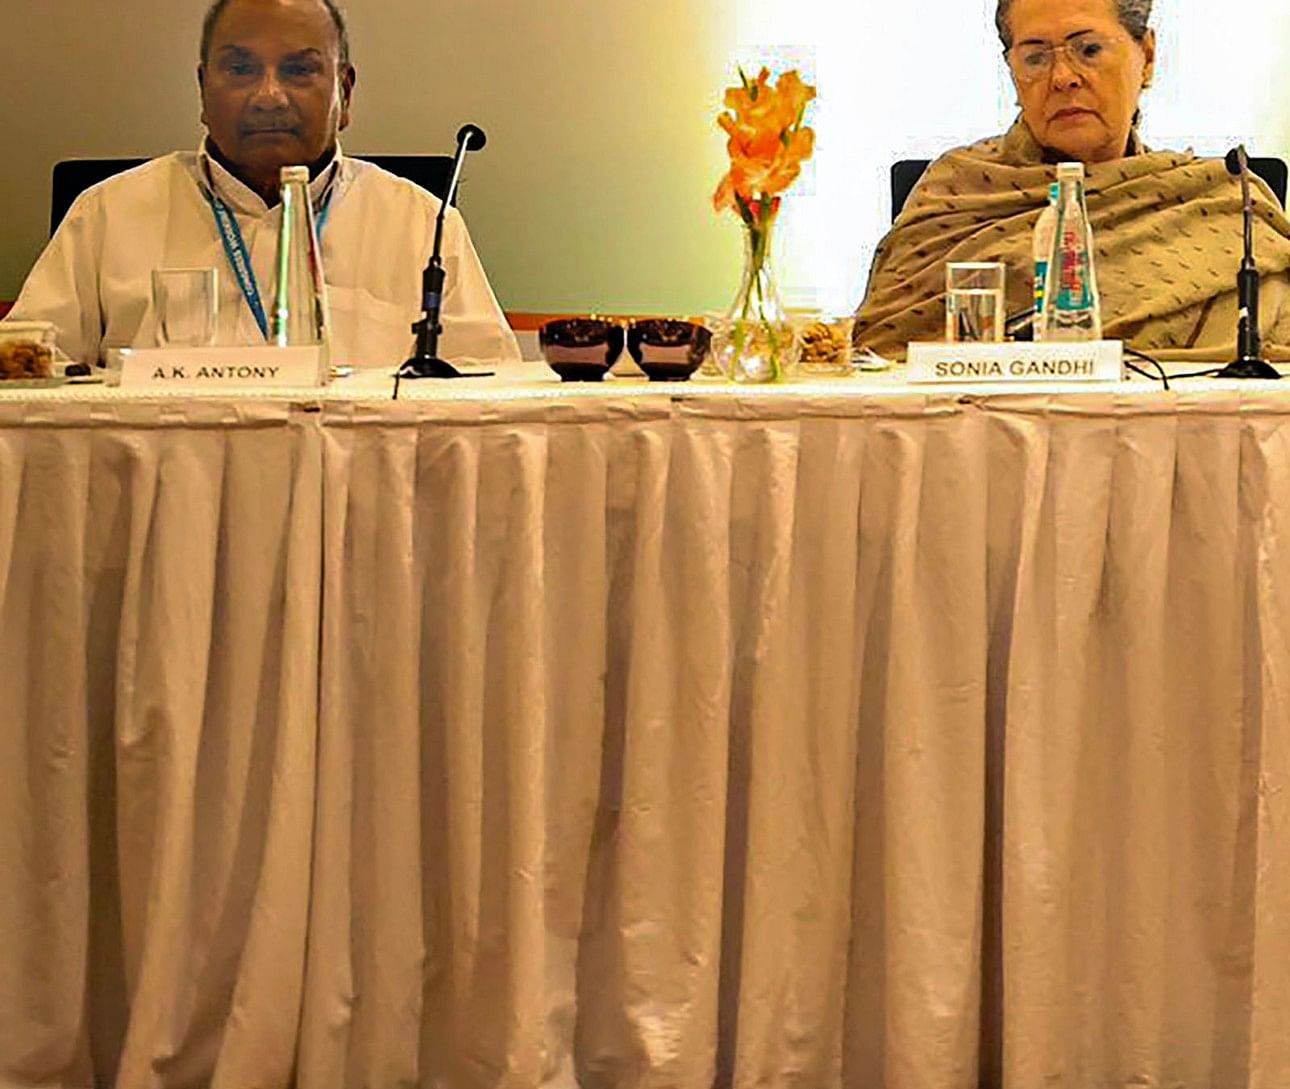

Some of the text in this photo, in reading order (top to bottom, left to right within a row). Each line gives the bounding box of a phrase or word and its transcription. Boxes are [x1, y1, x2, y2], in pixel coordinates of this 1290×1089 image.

[152, 366, 279, 379] A.K. ANTONY
[935, 359, 1095, 377] SONIA GANDHI
